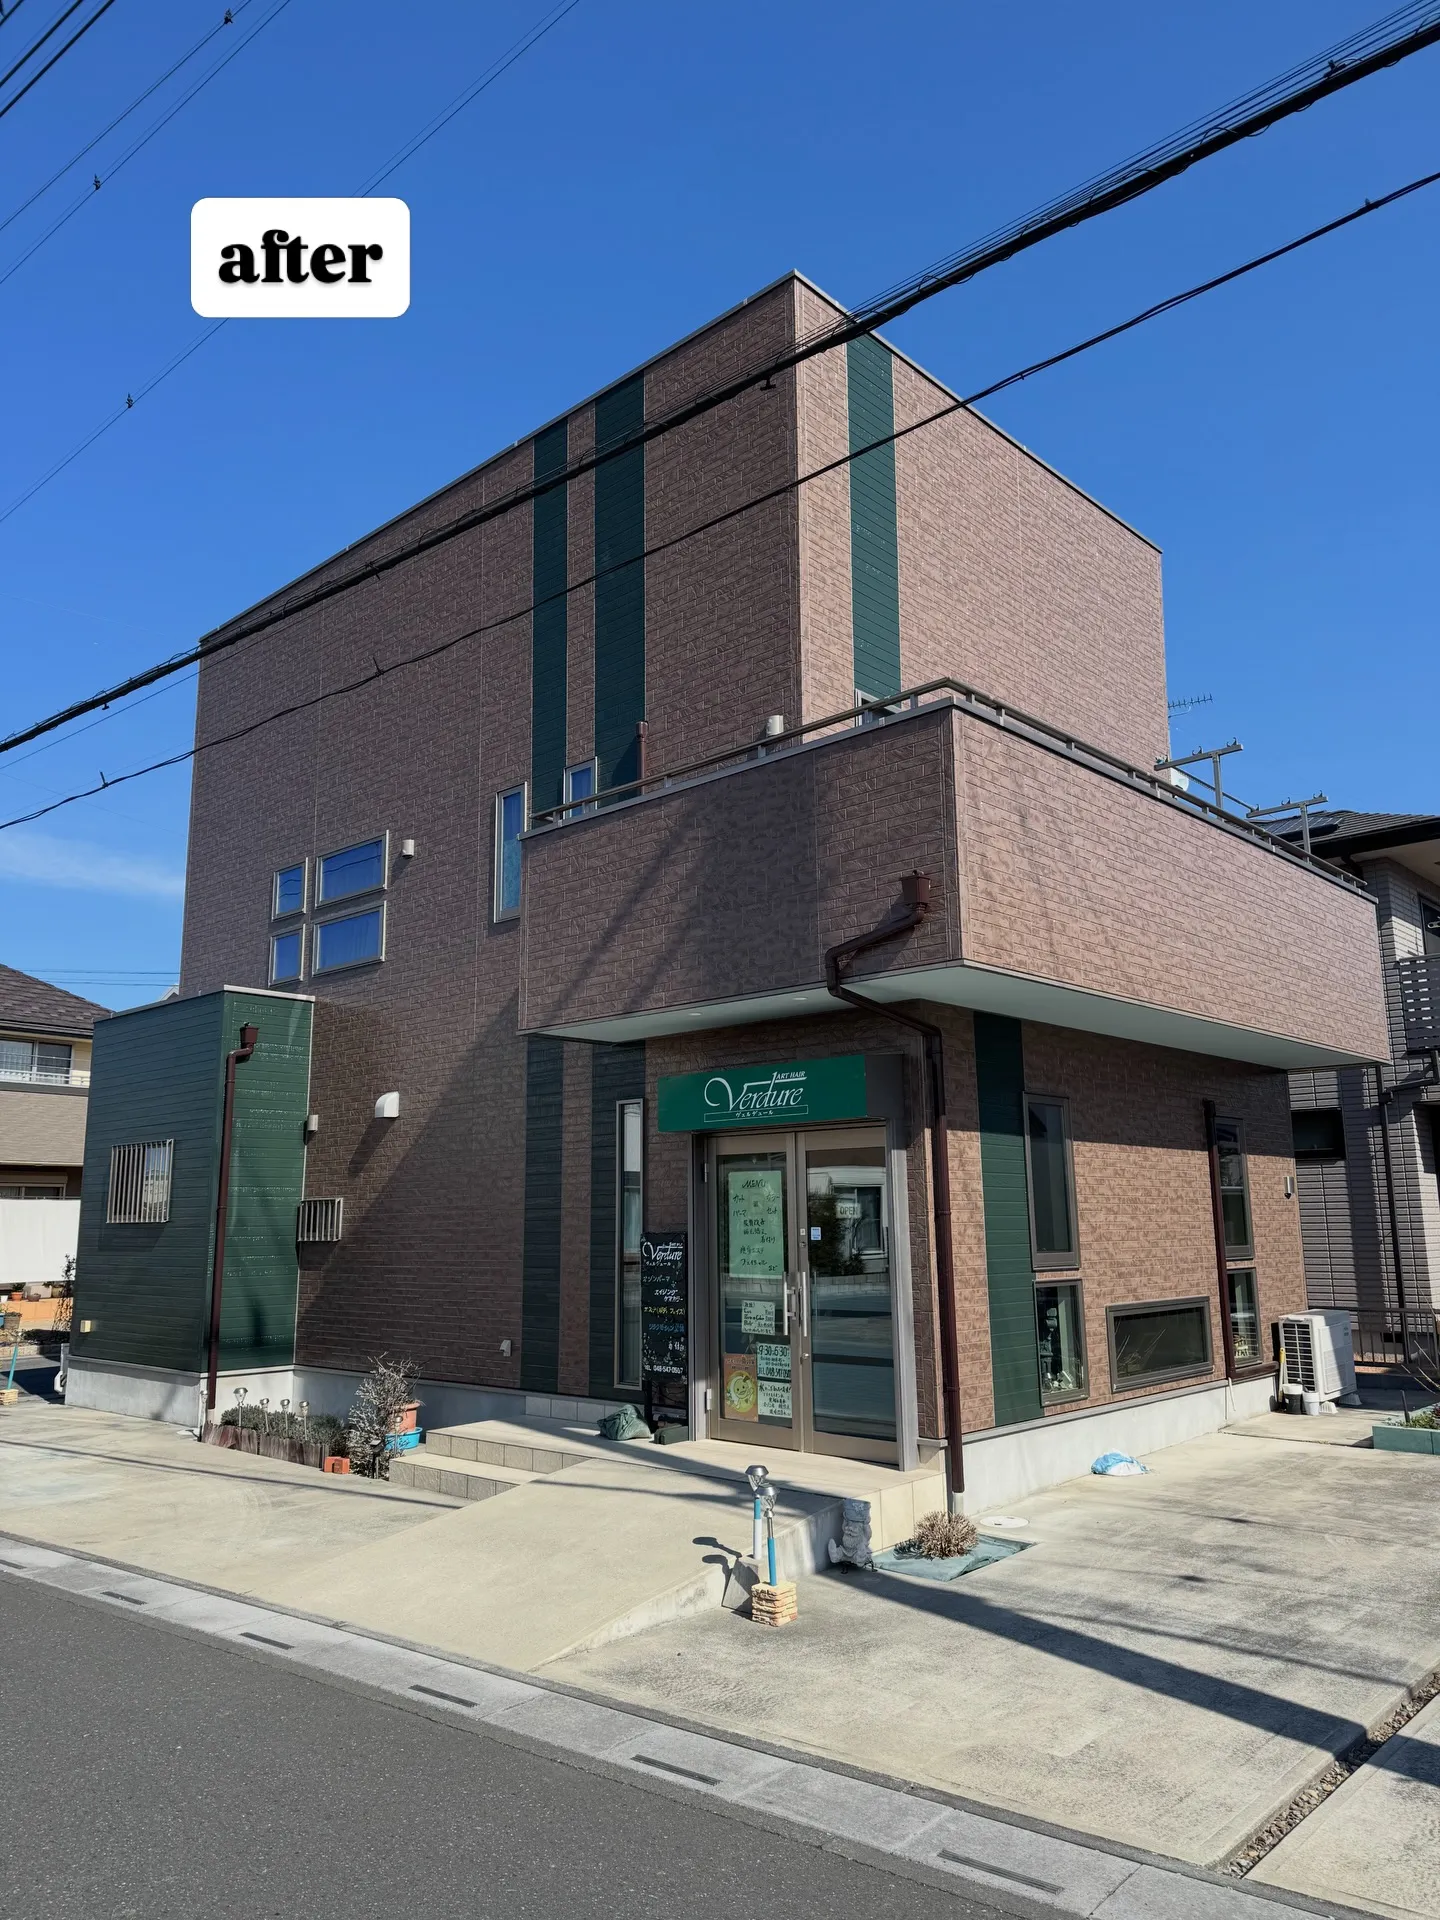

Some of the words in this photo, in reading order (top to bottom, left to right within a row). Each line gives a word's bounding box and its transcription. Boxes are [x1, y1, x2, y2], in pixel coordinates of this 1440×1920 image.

[776, 1072, 789, 1080] ART
[790, 1070, 806, 1078] HAIR
[704, 1071, 807, 1111] Verdure
[742, 1179, 766, 1189] MENU
[839, 1206, 858, 1216] OPEN
